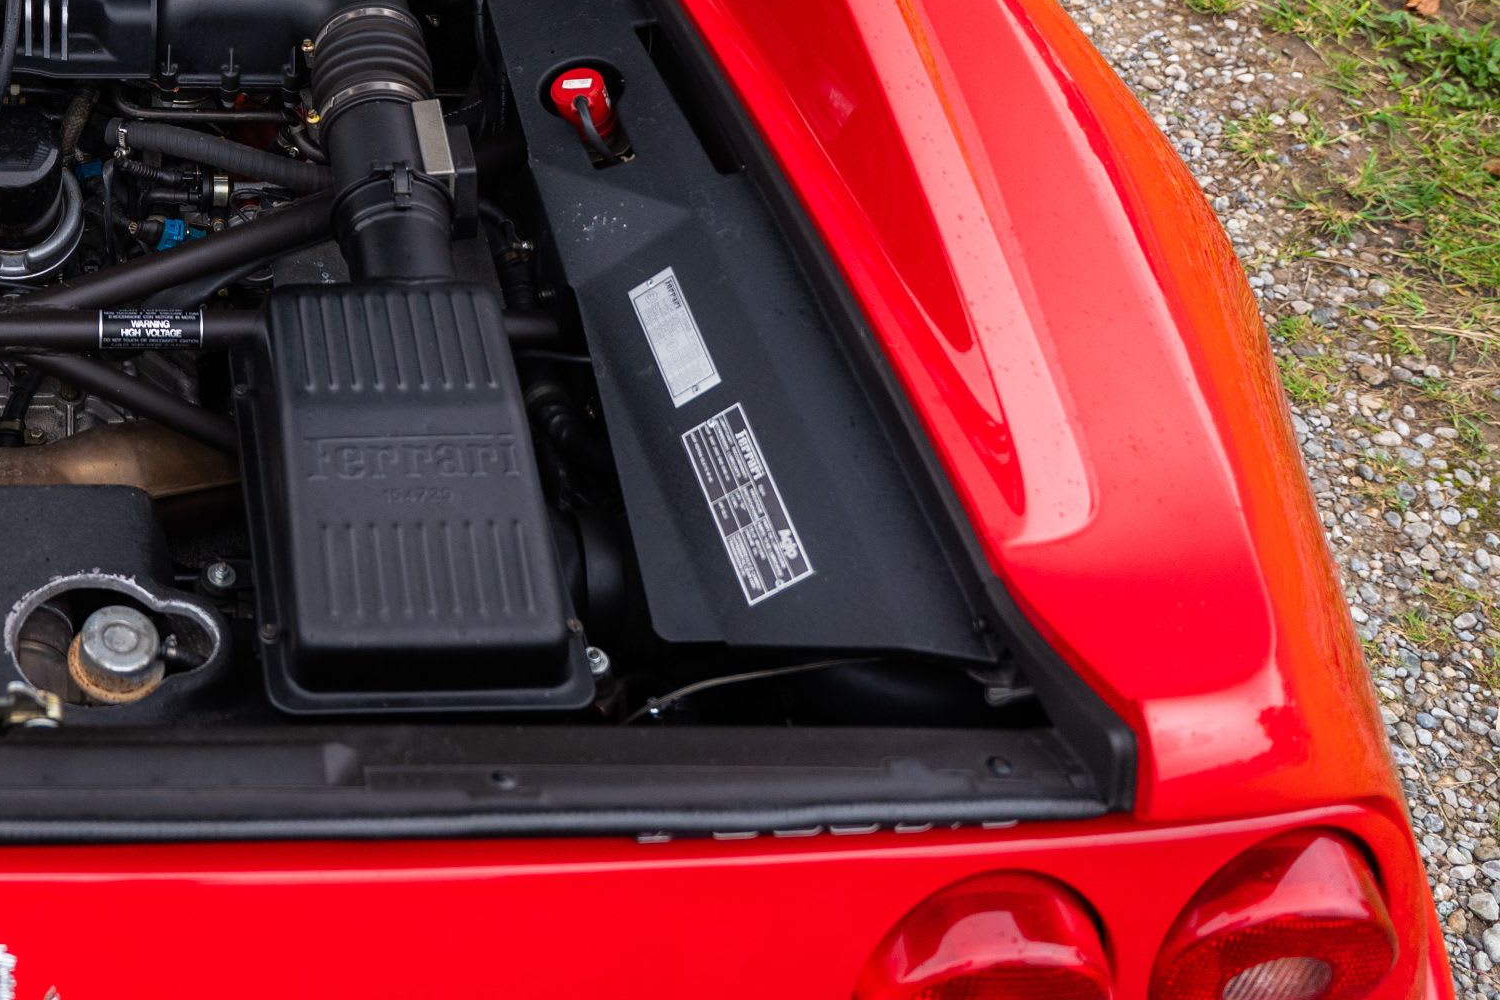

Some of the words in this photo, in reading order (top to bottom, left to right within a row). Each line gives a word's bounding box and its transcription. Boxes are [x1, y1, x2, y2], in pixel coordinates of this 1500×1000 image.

[665, 279, 682, 310] Ferrari
[120, 328, 141, 337] HIGH
[145, 329, 182, 338] VOLTAGE
[131, 320, 170, 328] WARNING
[303, 433, 520, 481] Ferrari
[735, 428, 765, 480] Ferrari
[777, 528, 799, 560] Agip
